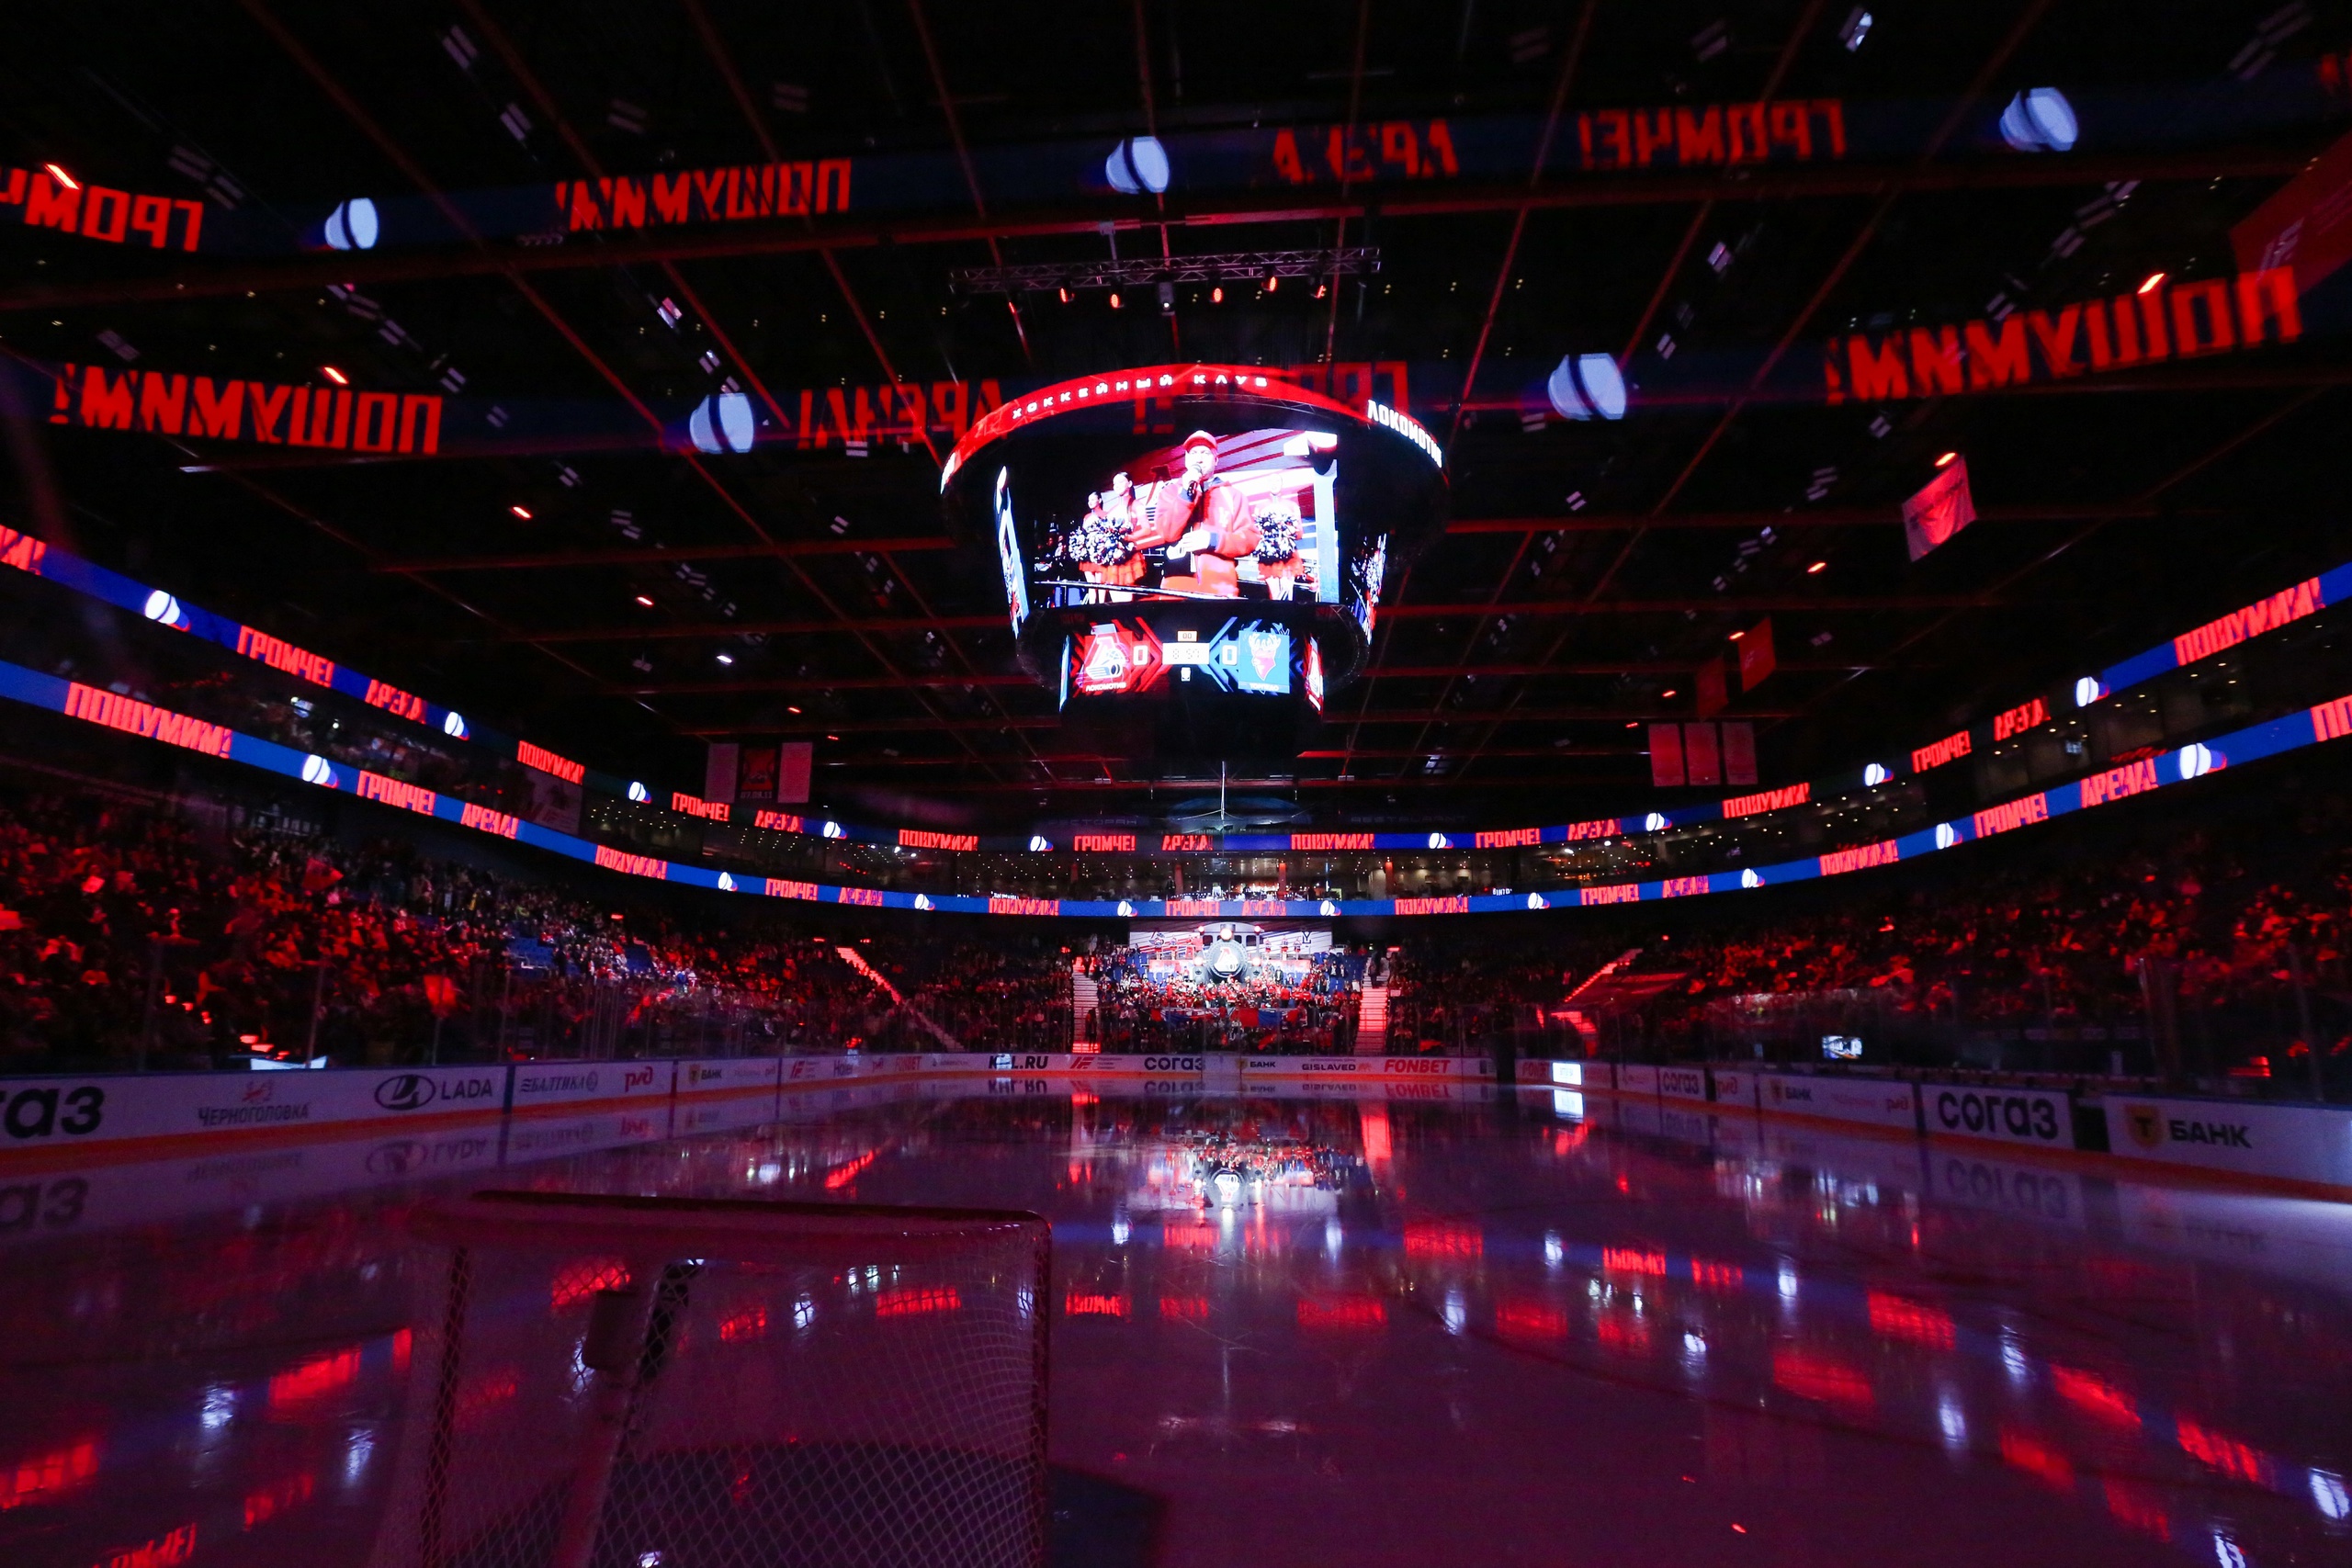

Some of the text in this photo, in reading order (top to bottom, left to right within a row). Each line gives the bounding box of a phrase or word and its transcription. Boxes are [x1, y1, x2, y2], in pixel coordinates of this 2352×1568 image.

[1012, 373, 1268, 420] ХОККЕЙНЫЙ КЛУБ
[237, 625, 334, 688] ГРОМЧЕ!
[1133, 645, 1148, 666] 0
[1221, 645, 1238, 666] 0
[64, 682, 232, 760] ПОШУМИМ!
[1912, 730, 1973, 773] ГРОМЧЕ!
[357, 770, 519, 840] ГРОМЧЕ! АРЕНА!
[673, 792, 730, 822] ГРОМЧЕ!
[1722, 782, 1810, 819] ПОШУМИМ!
[1973, 756, 2158, 839] ГРОМЧЕ! АРЕНА!
[899, 829, 978, 852] ПОШУМИМ!
[1074, 835, 1136, 852] ГРОМЧЕ!
[1291, 833, 1375, 851] ПОШУМИМ!
[1476, 829, 1541, 849] ГРОМЧЕ!
[765, 877, 819, 901] ГРОМЧЕ!
[1581, 884, 1640, 906] ГРОМЧЕ!
[1166, 900, 1219, 917] ГРОМЧЕ!
[702, 1069, 722, 1080] БАНК
[1250, 1061, 1276, 1069] БАНК
[1302, 1063, 1356, 1072] GISLAVED
[1384, 1059, 1452, 1075] FONBET
[440, 1078, 493, 1100] LADA
[198, 1103, 310, 1127] ЧЕРНОГОЛОВКА
[2168, 1119, 2252, 1149] БАНК
